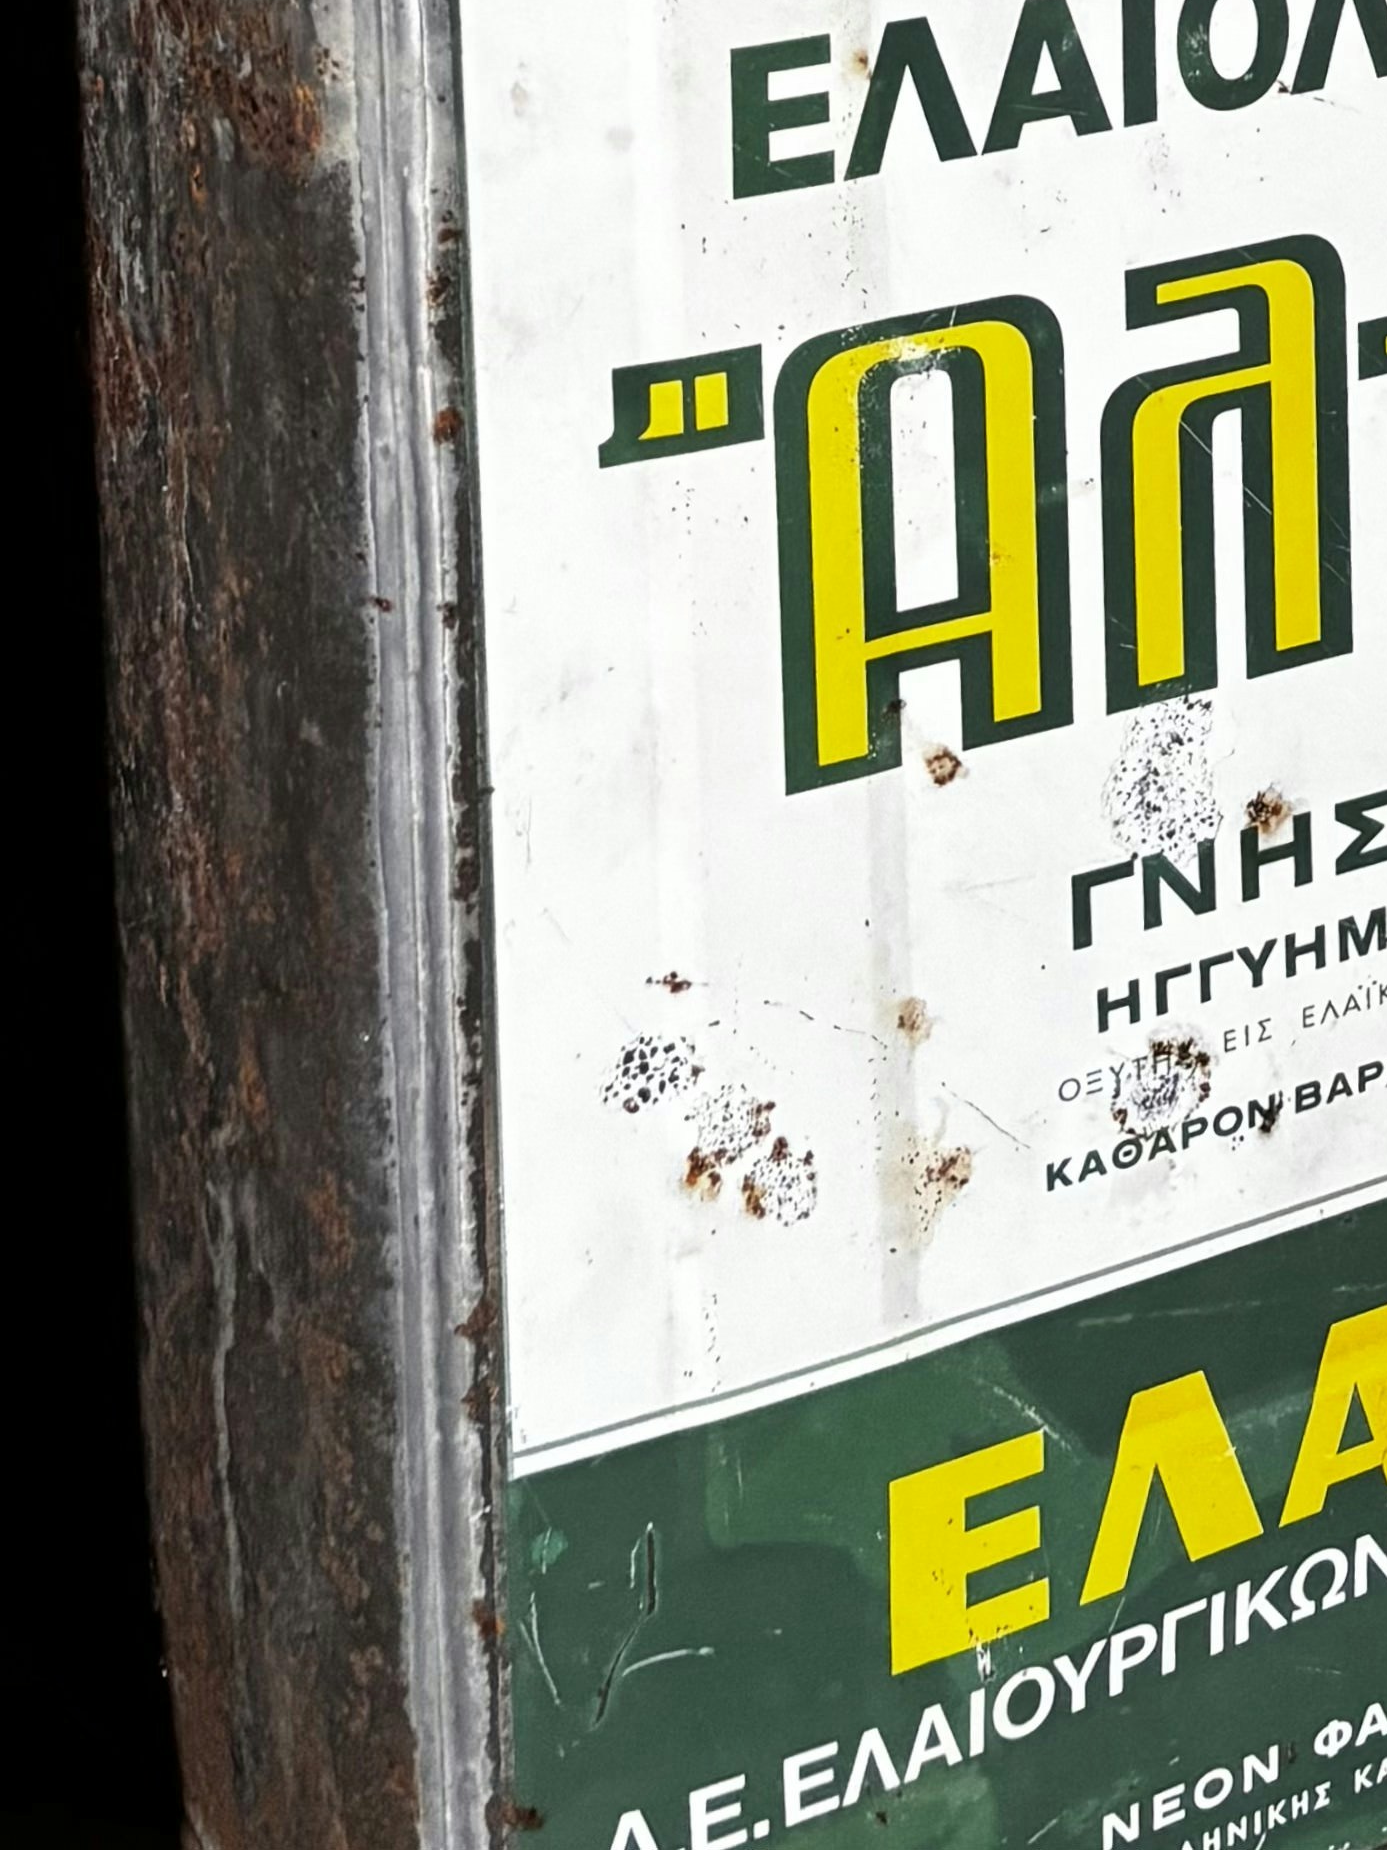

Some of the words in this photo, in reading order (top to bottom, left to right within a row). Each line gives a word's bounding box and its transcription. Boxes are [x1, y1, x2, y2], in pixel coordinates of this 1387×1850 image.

[1223, 1017, 1272, 1053] ΕΙΣ
[1046, 1092, 1282, 1192] ΚΑΘΑΡΟΝ
[1102, 1744, 1280, 1850] ΝΕΟΝ
